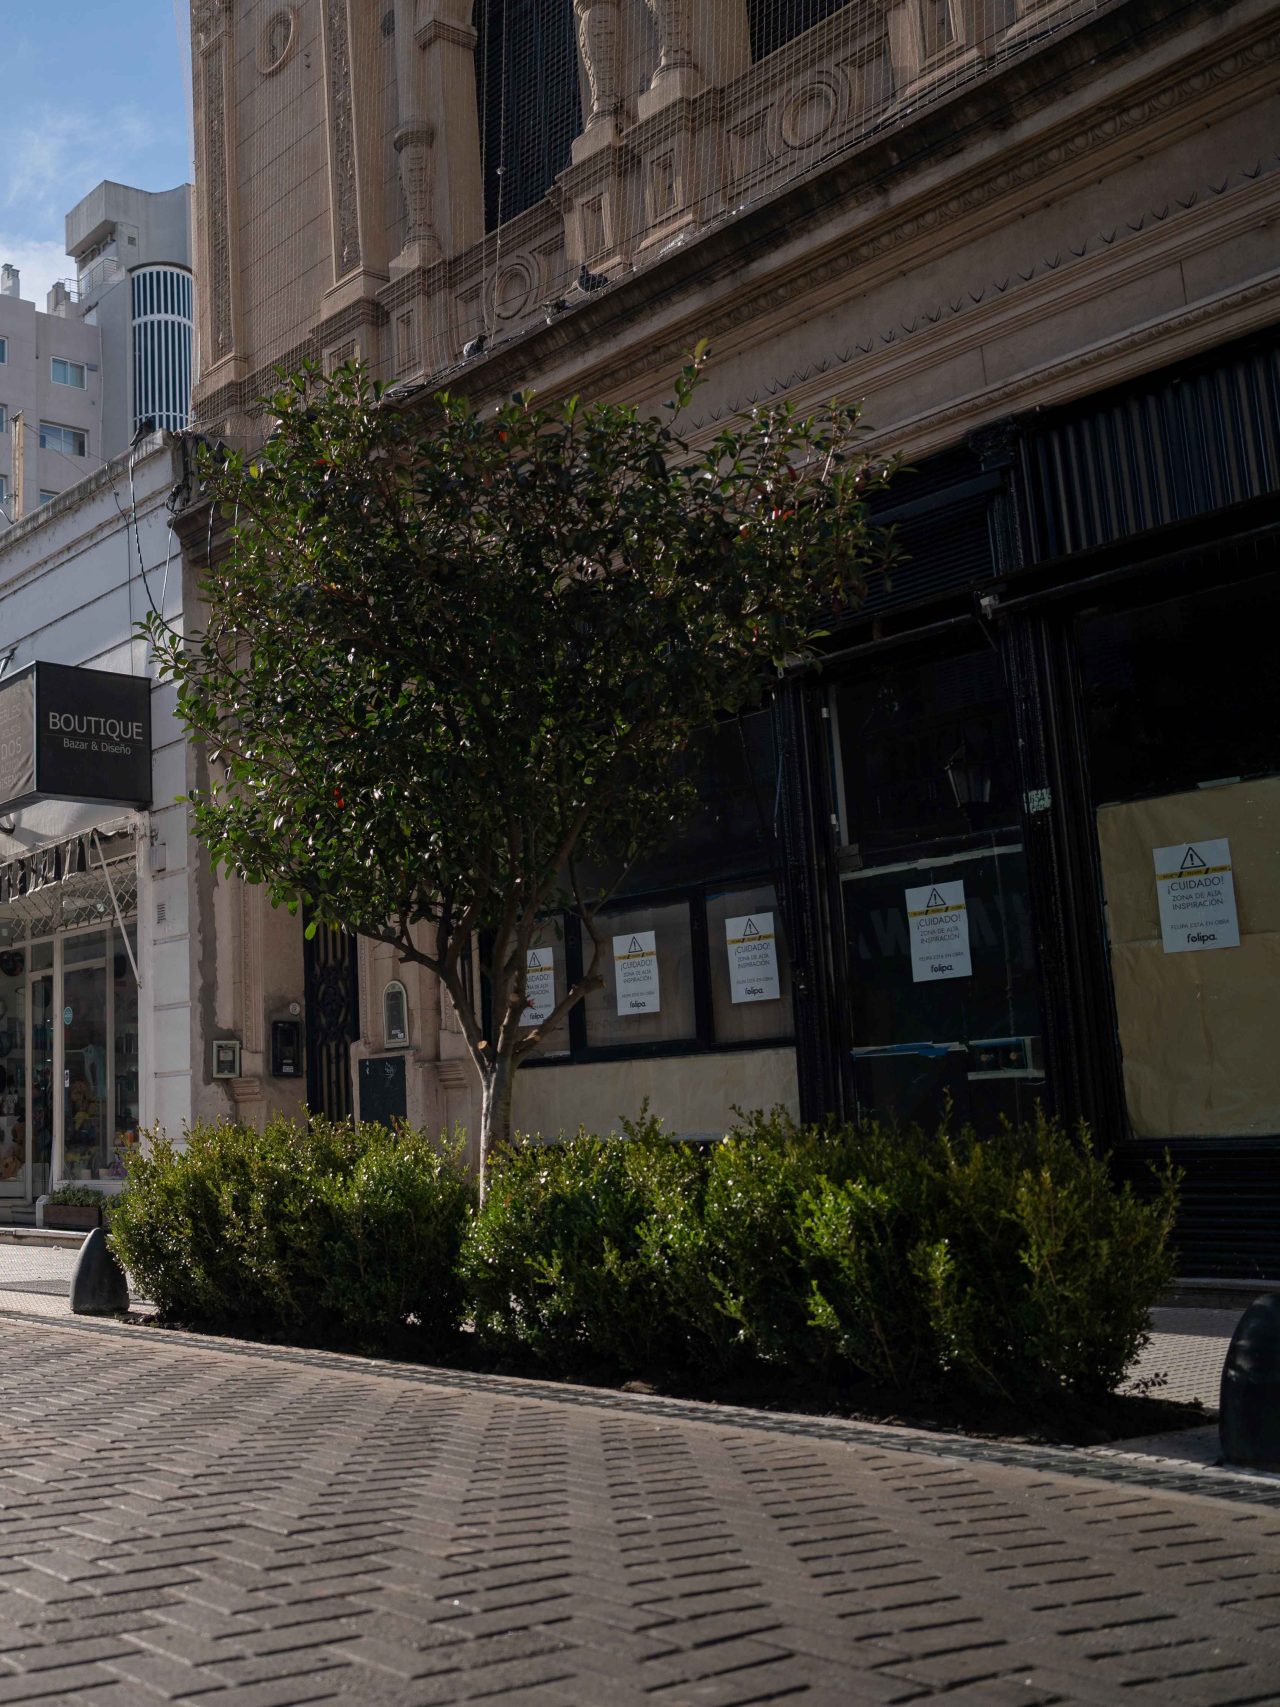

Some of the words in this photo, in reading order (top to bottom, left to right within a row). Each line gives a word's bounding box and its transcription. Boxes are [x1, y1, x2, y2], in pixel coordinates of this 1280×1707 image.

[49, 711, 143, 741] BOUTIQUE
[63, 737, 88, 750] Bazar
[91, 741, 98, 751] &
[101, 742, 131, 755] Diseño
[1167, 876, 1224, 895] ¡CUIDADO!
[1172, 894, 1193, 902] ZONA
[1195, 891, 1205, 899] DE
[1207, 889, 1222, 897] ALTA
[1172, 898, 1224, 911] INSPIRACIÓN
[917, 914, 961, 930] ¡CUIDADO!
[735, 942, 771, 956] ¡CUIDADO!
[621, 959, 653, 972] ¡CUIDADO!
